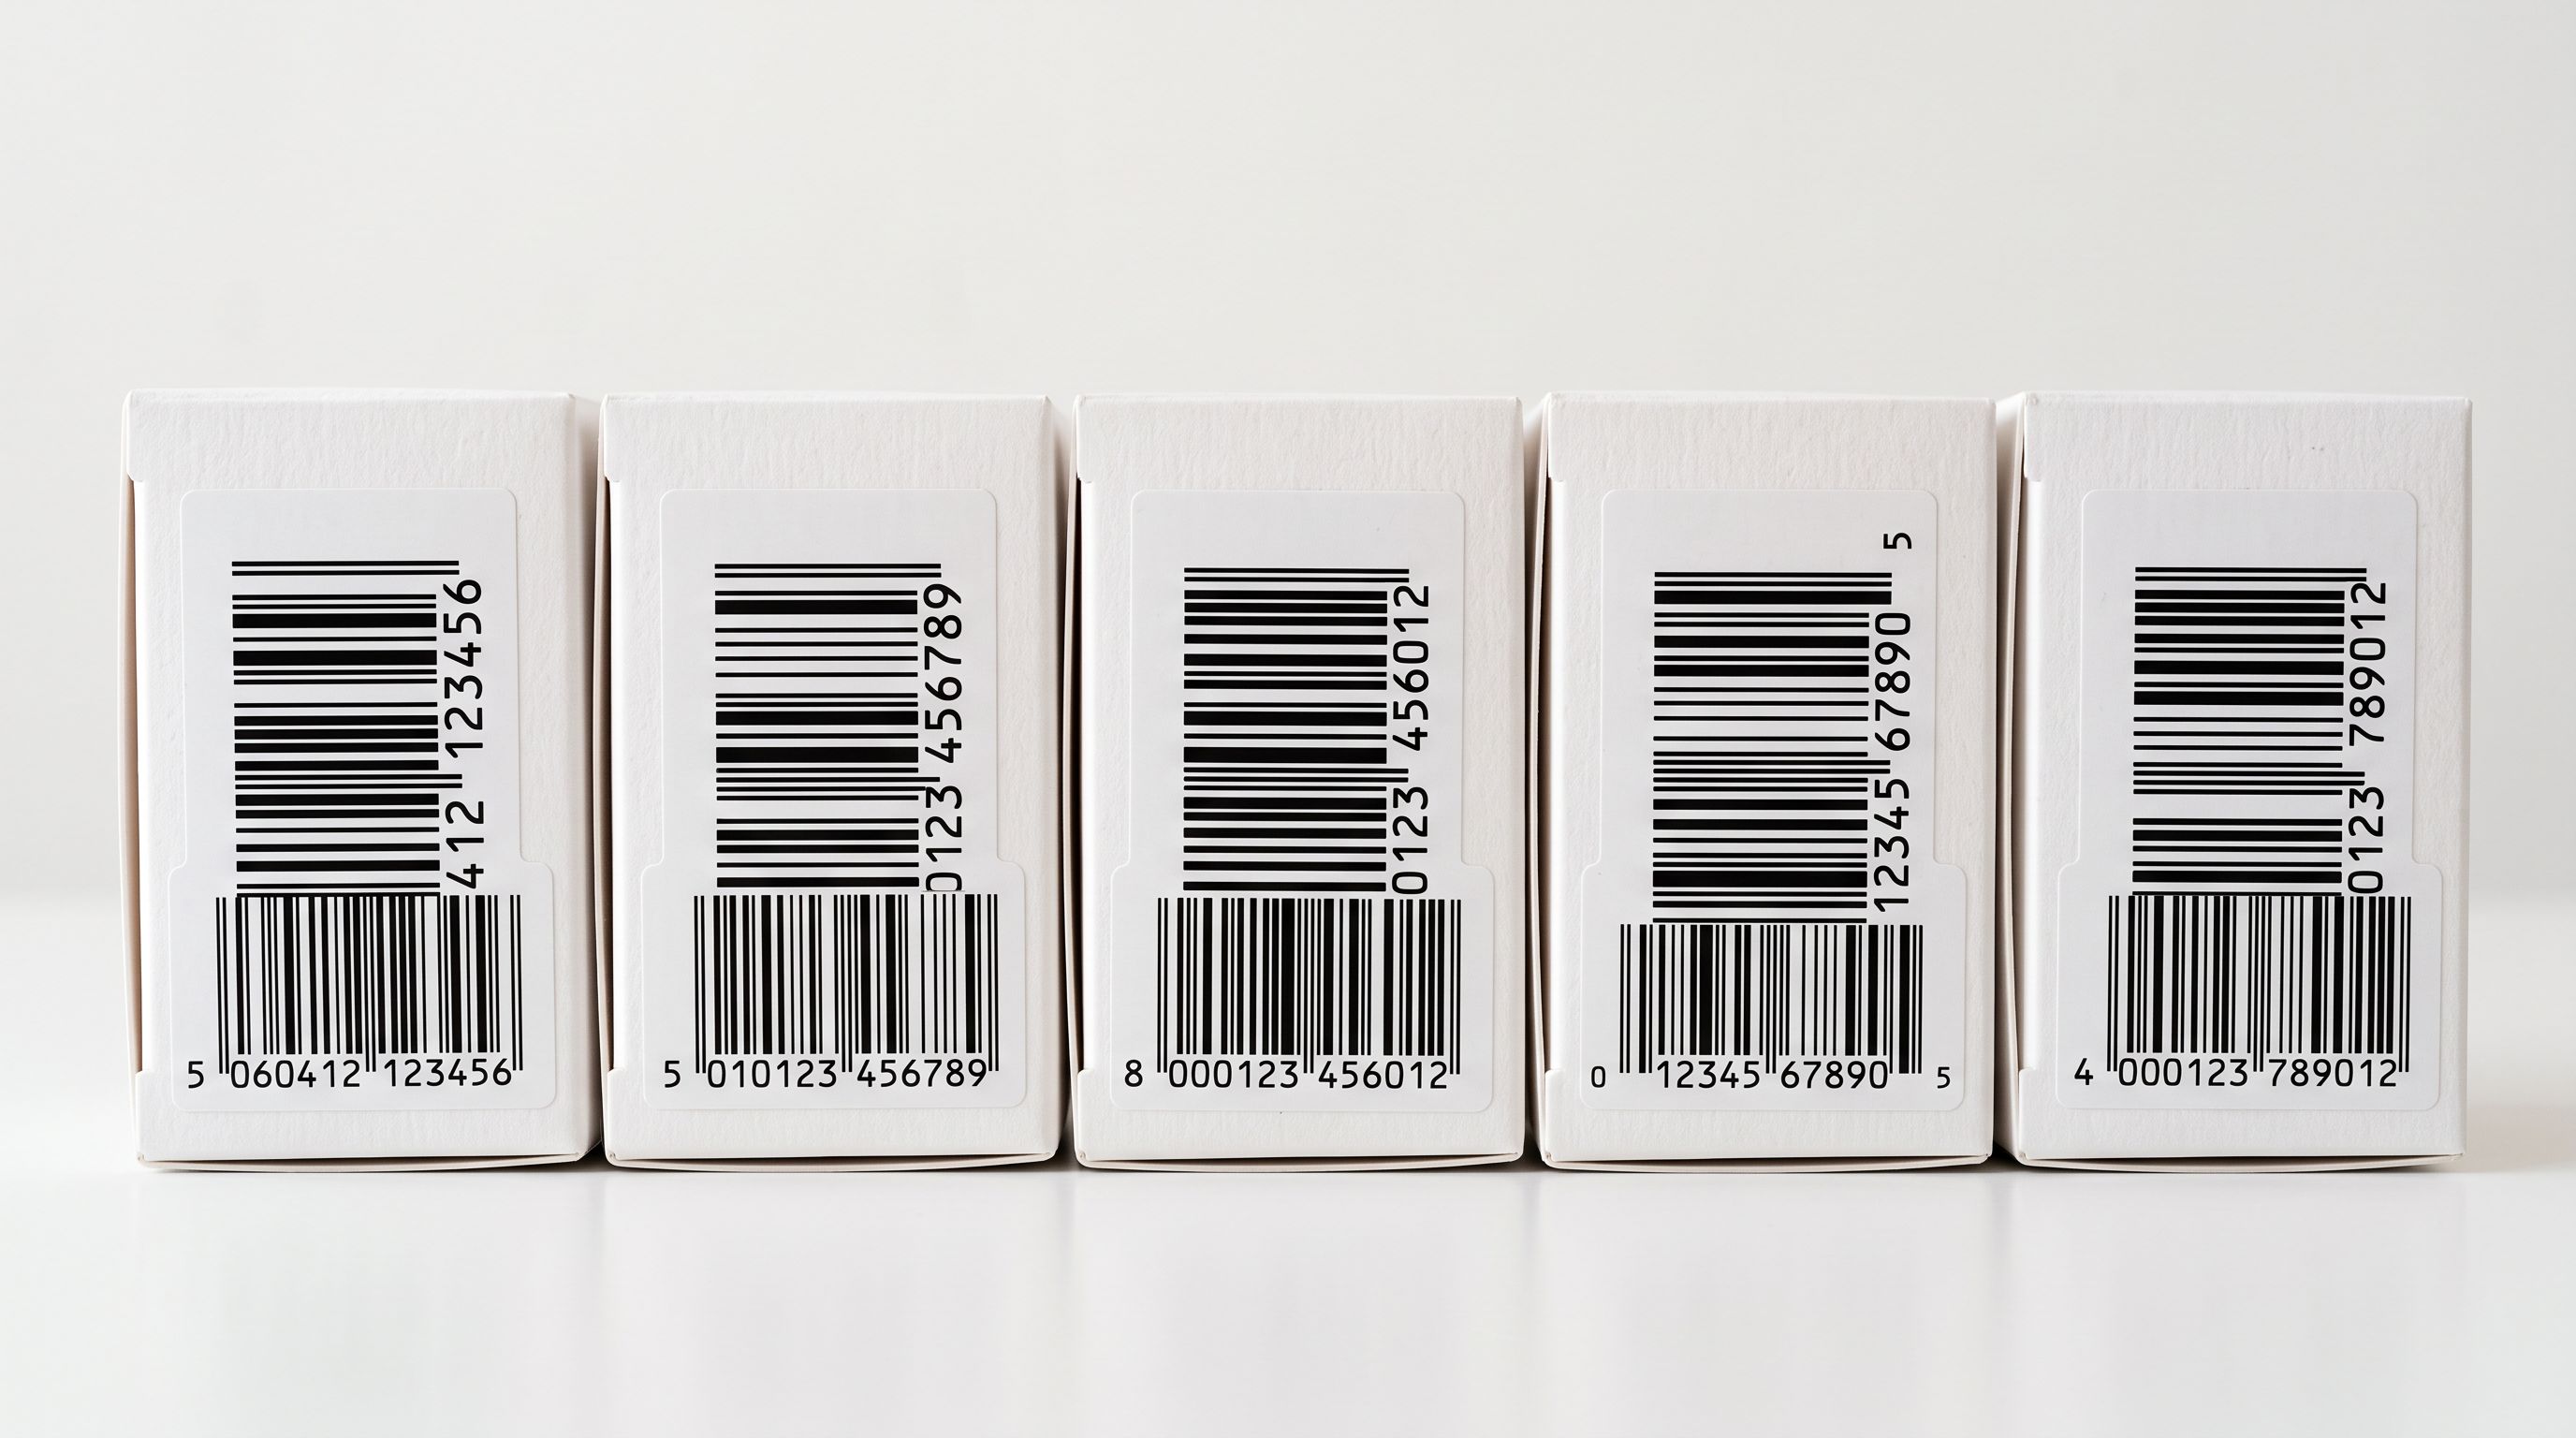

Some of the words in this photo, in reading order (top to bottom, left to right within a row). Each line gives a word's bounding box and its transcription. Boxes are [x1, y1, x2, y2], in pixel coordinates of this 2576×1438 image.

[1883, 533, 1912, 550] 5
[443, 579, 483, 758] 123456
[923, 583, 962, 763] 456789
[1392, 585, 1429, 752] 456012
[1874, 612, 1911, 751] 67890
[2349, 582, 2386, 746] 789012
[445, 800, 484, 889] 412
[1391, 786, 1428, 894] 0123
[1873, 778, 1910, 912] 12345
[2348, 786, 2384, 894] 0123
[187, 1061, 204, 1088] 5
[230, 1059, 360, 1089] 060412
[384, 1058, 512, 1087] 123456
[665, 1060, 681, 1088] 5
[707, 1059, 837, 1088] 010123
[856, 1058, 988, 1087] 456789
[1124, 1059, 1144, 1088] 8
[1168, 1059, 1298, 1088] 000123
[1318, 1060, 1447, 1089] 456012
[1591, 1065, 1605, 1088] 0
[1657, 1060, 1761, 1089] 12345
[1780, 1060, 1888, 1089] 67890
[1937, 1066, 1951, 1089] 5
[2074, 1058, 2094, 1086] 4
[2118, 1058, 2247, 1087] 000123
[2268, 1059, 2397, 1087] 789012
